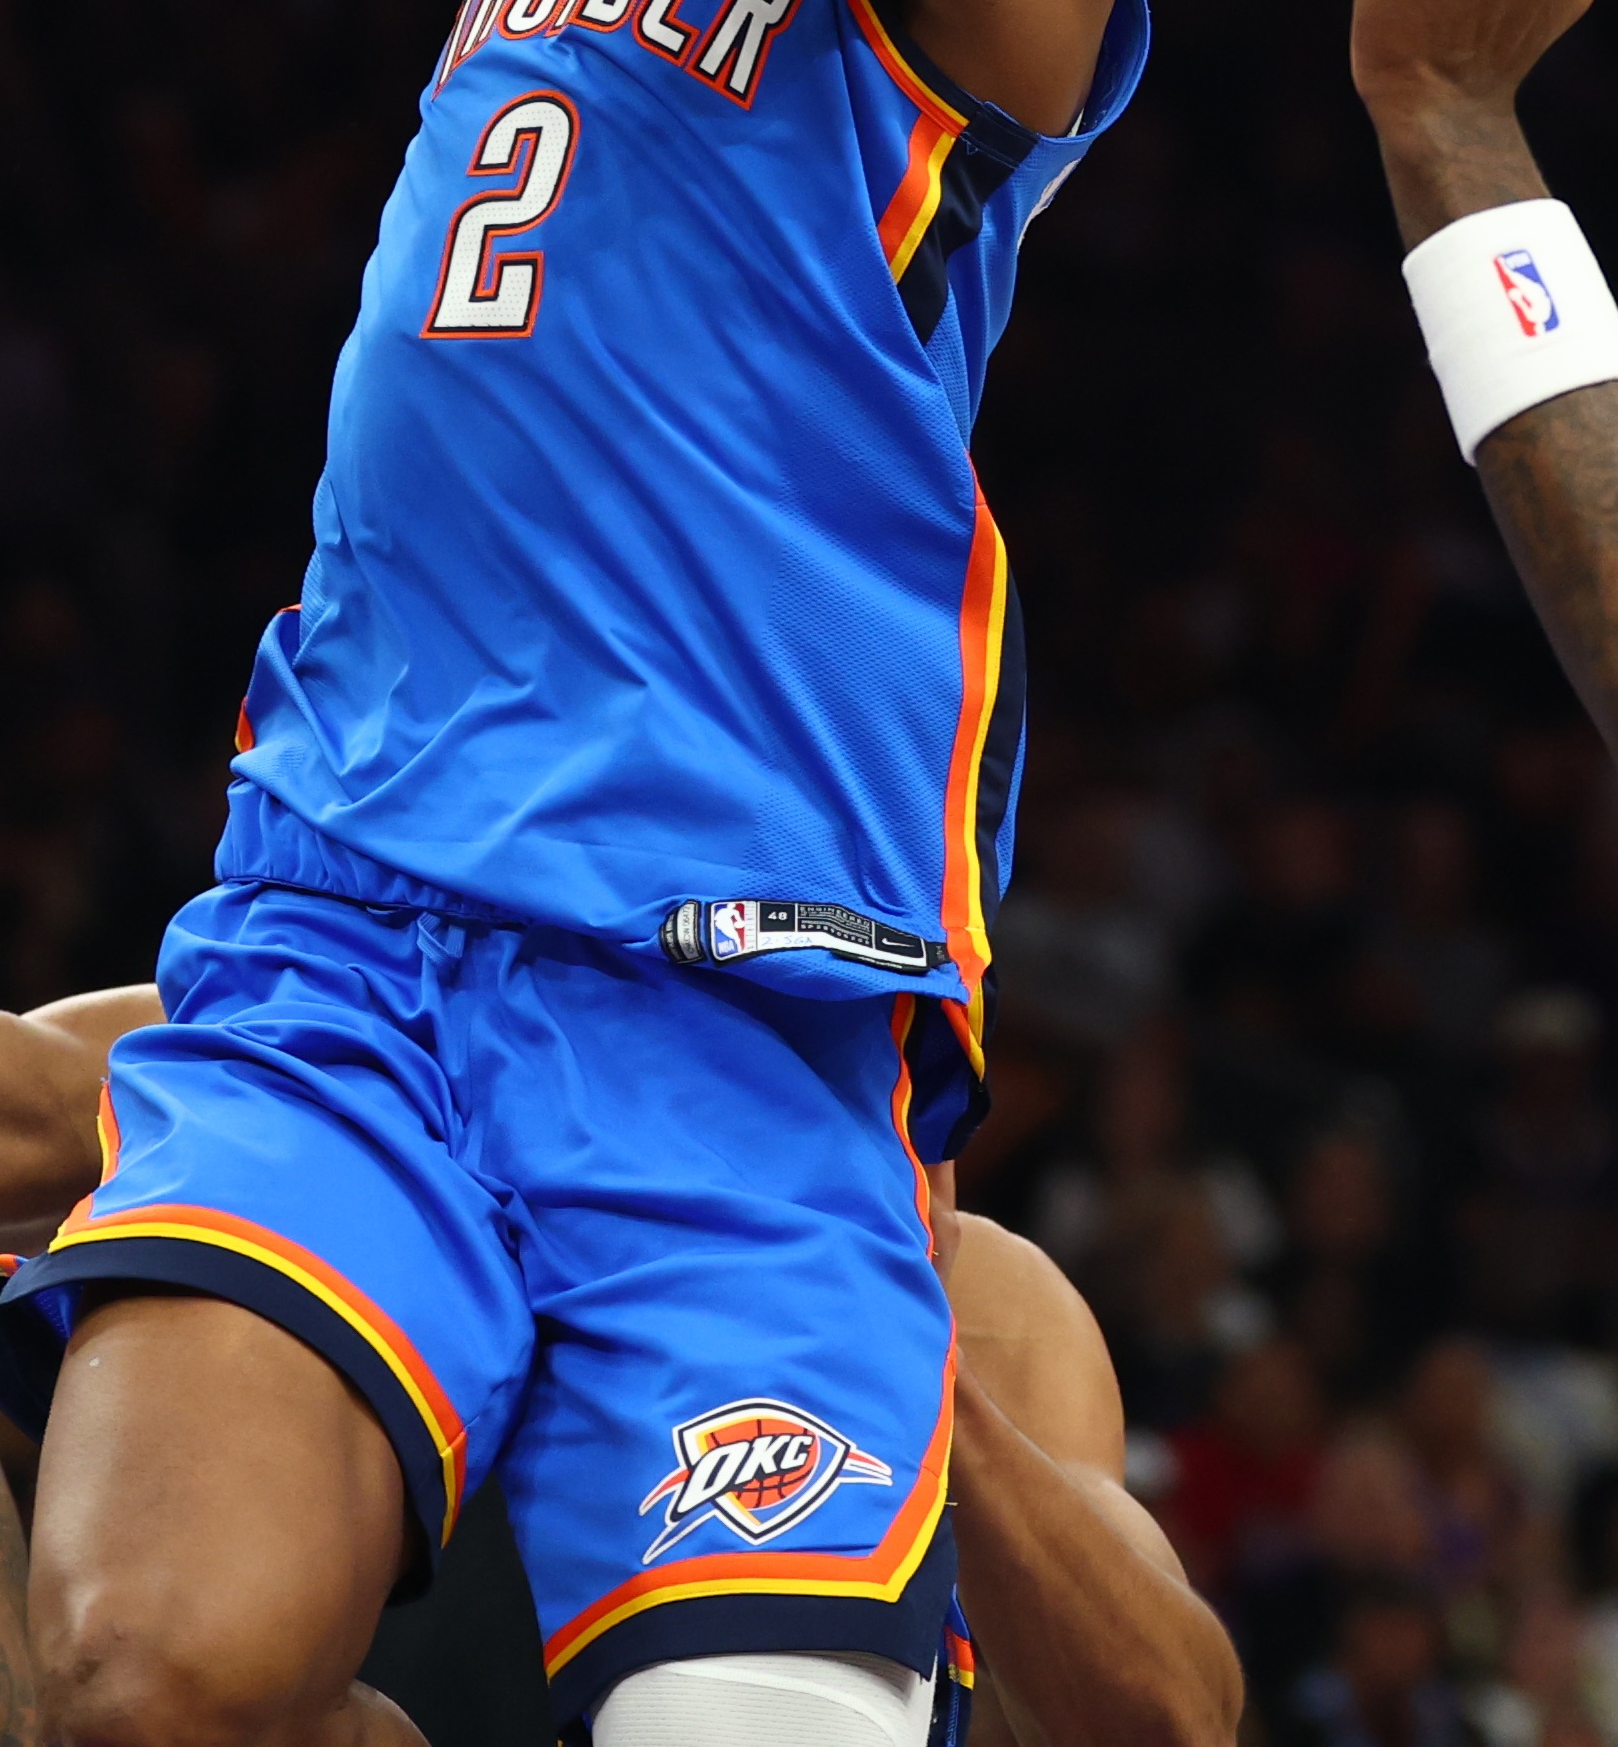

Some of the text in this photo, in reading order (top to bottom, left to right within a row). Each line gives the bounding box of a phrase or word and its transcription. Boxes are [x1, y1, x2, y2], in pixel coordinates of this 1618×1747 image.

[420, 90, 580, 339] 2
[767, 911, 788, 921] 48
[675, 1434, 815, 1517] OKC
